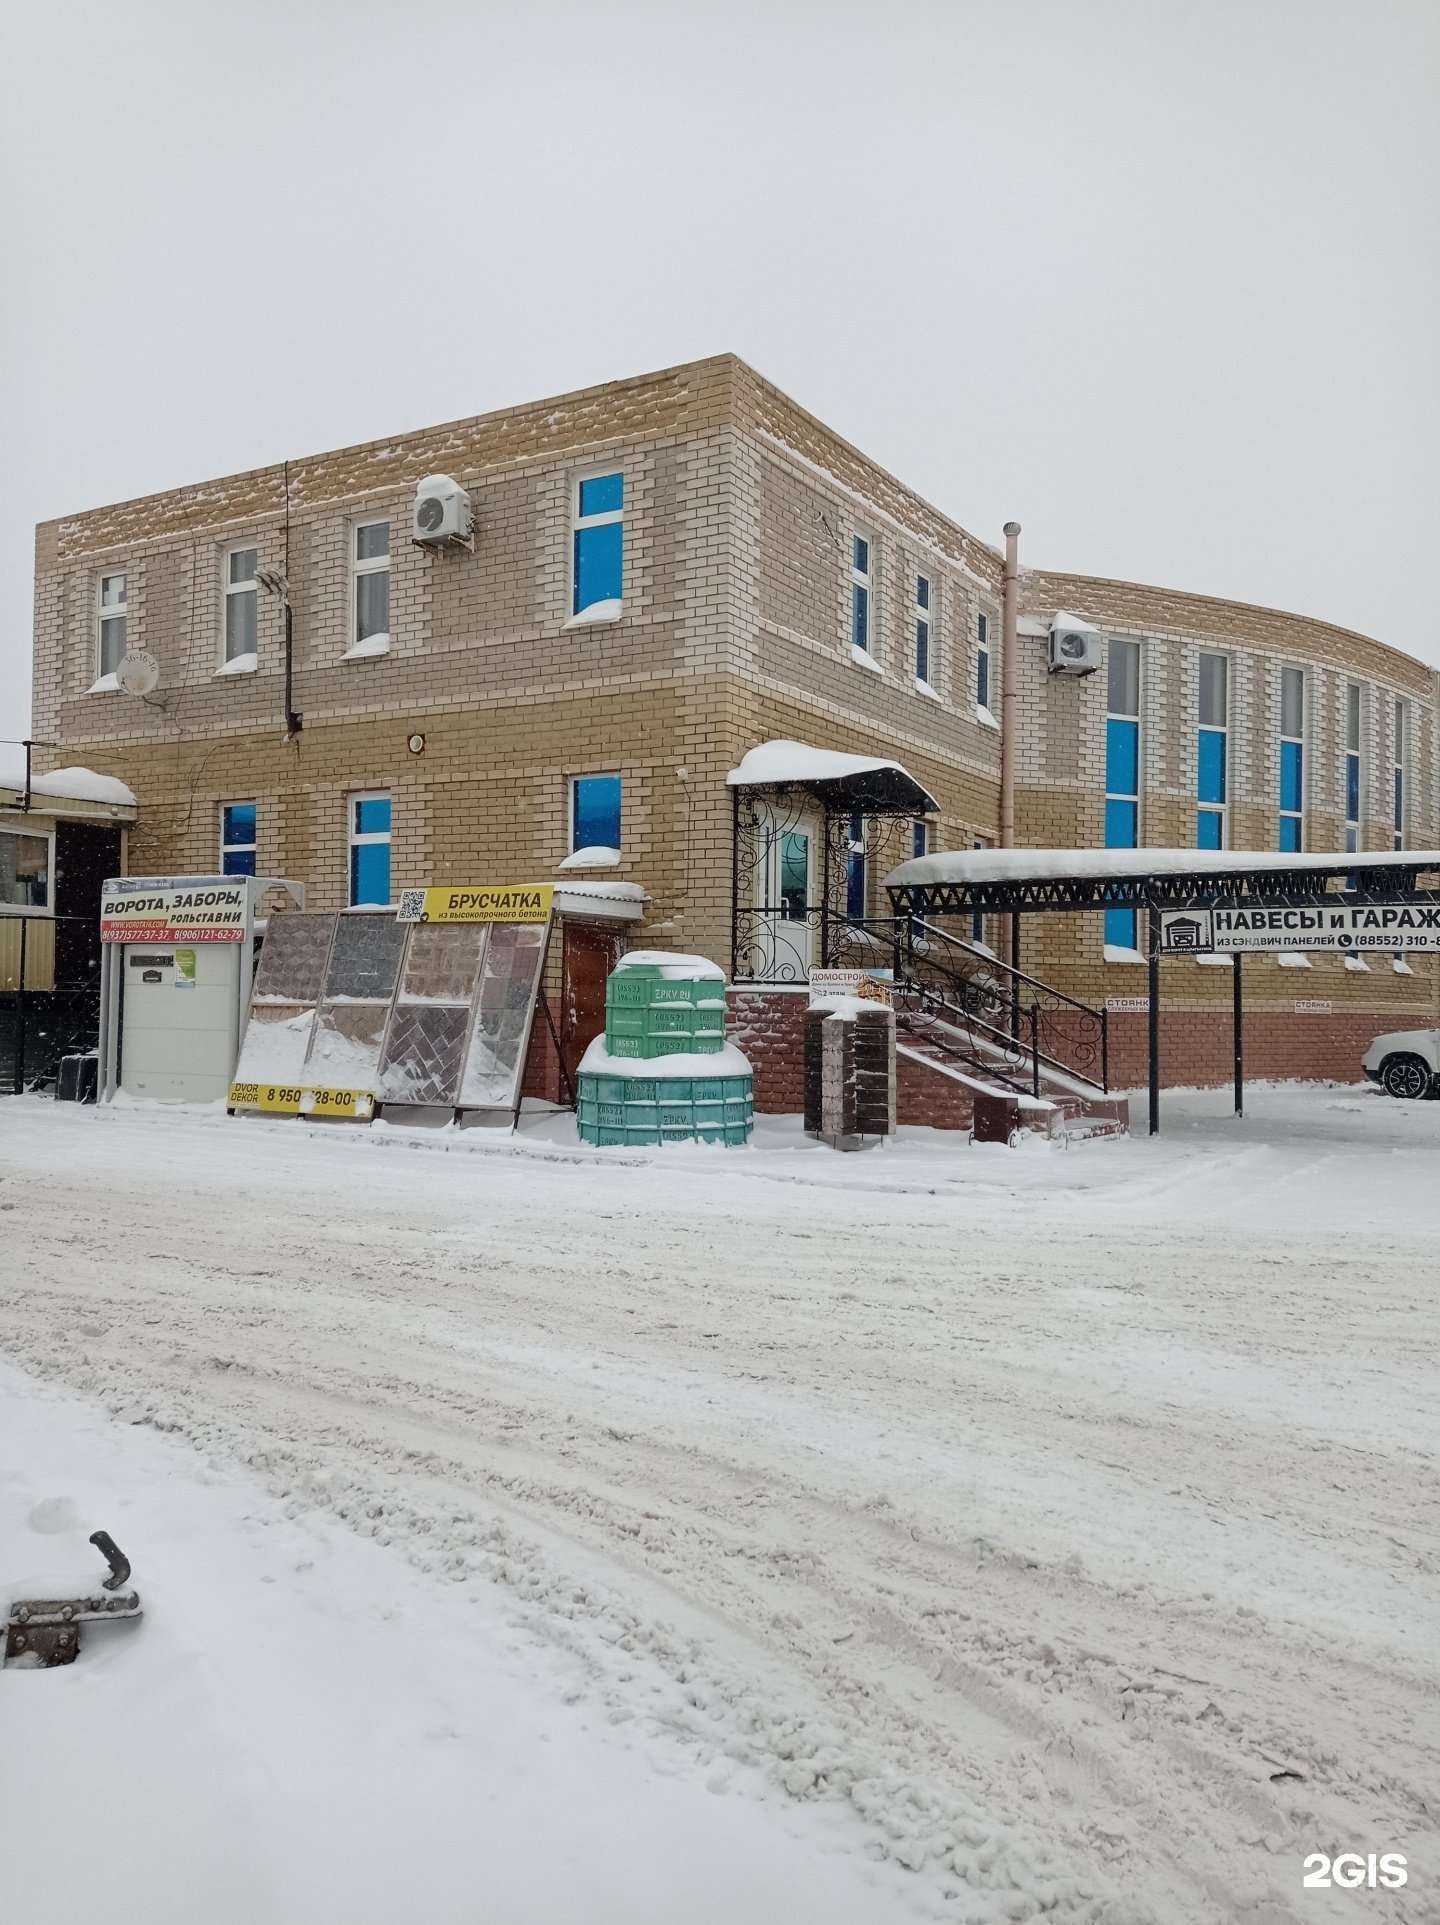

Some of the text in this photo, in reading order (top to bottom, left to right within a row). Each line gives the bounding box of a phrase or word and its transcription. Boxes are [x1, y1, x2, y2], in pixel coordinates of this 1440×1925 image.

[104, 891, 242, 914] ВОРОТА, ЗАБОРЫ,
[448, 892, 542, 909] БРУСЧАТКА
[171, 911, 242, 923] РОЛЬСТАВНИ
[449, 910, 517, 920] высокопрочного
[518, 909, 548, 918] бетона
[1215, 910, 1323, 930] НАВЕСЫ
[1330, 914, 1345, 928] и
[1351, 909, 1440, 928] ГАРАЖ
[174, 929, 243, 940] 8(906)121-62-79
[1217, 938, 1232, 946] ИЗ
[1232, 937, 1281, 946] СЭНДВИЧ
[1283, 934, 1335, 946] ПАНЕЛЕЙ
[1354, 935, 1404, 946] (88552)
[1405, 935, 1427, 946] 310
[811, 971, 865, 982] ДОМОСТРОЙ
[235, 1082, 259, 1093] DVOR
[231, 1092, 259, 1103] DEKOR
[266, 1088, 276, 1101] 8
[279, 1089, 302, 1103] 950
